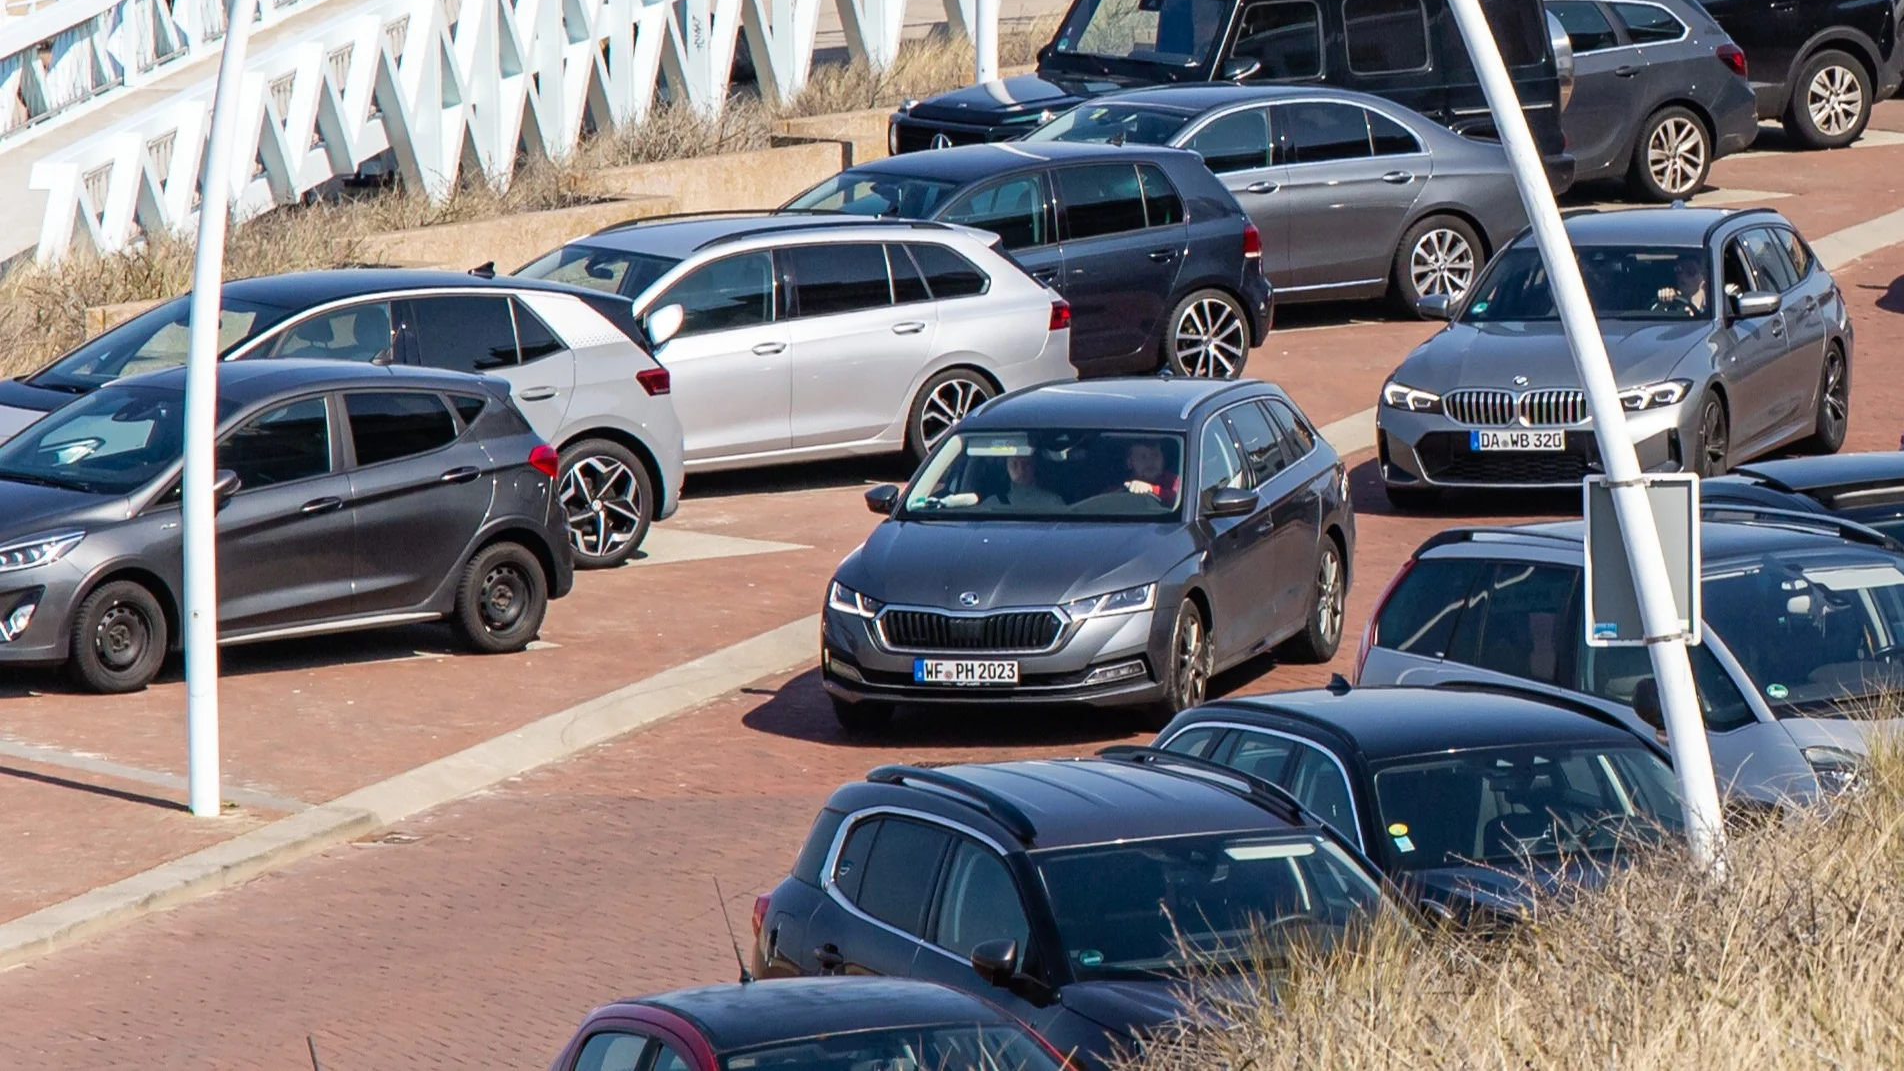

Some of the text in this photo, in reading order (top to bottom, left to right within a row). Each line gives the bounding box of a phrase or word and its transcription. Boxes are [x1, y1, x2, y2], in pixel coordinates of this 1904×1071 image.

[1481, 433, 1562, 448] DA WB 320
[925, 663, 1016, 680] WF PH 2023
